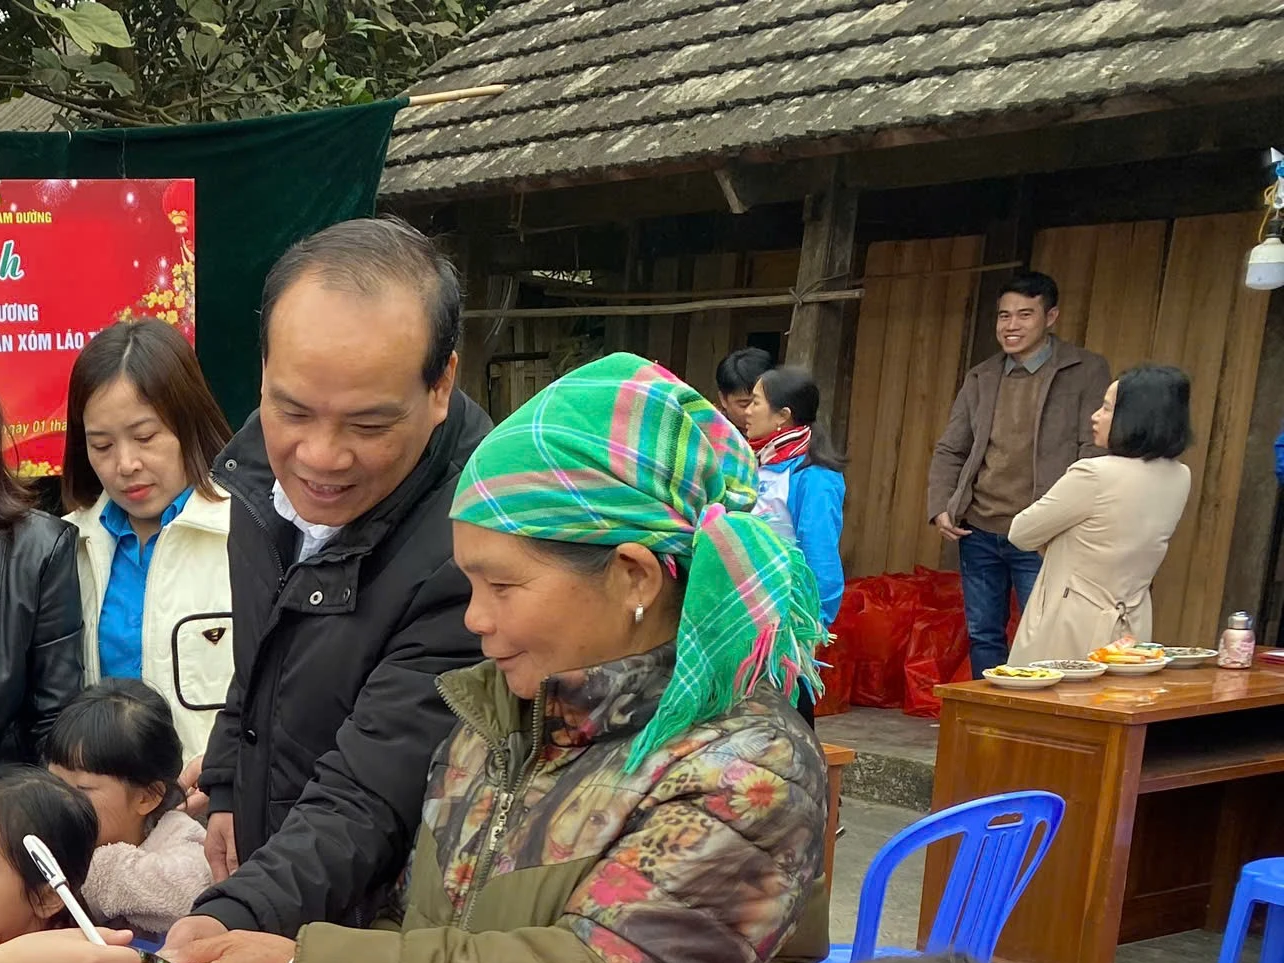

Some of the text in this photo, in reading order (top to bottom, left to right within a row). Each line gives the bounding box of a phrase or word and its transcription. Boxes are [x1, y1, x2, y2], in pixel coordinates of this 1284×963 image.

[17, 332, 52, 351] XÓM
[56, 330, 84, 350] LÁO
[32, 420, 48, 434] 01
